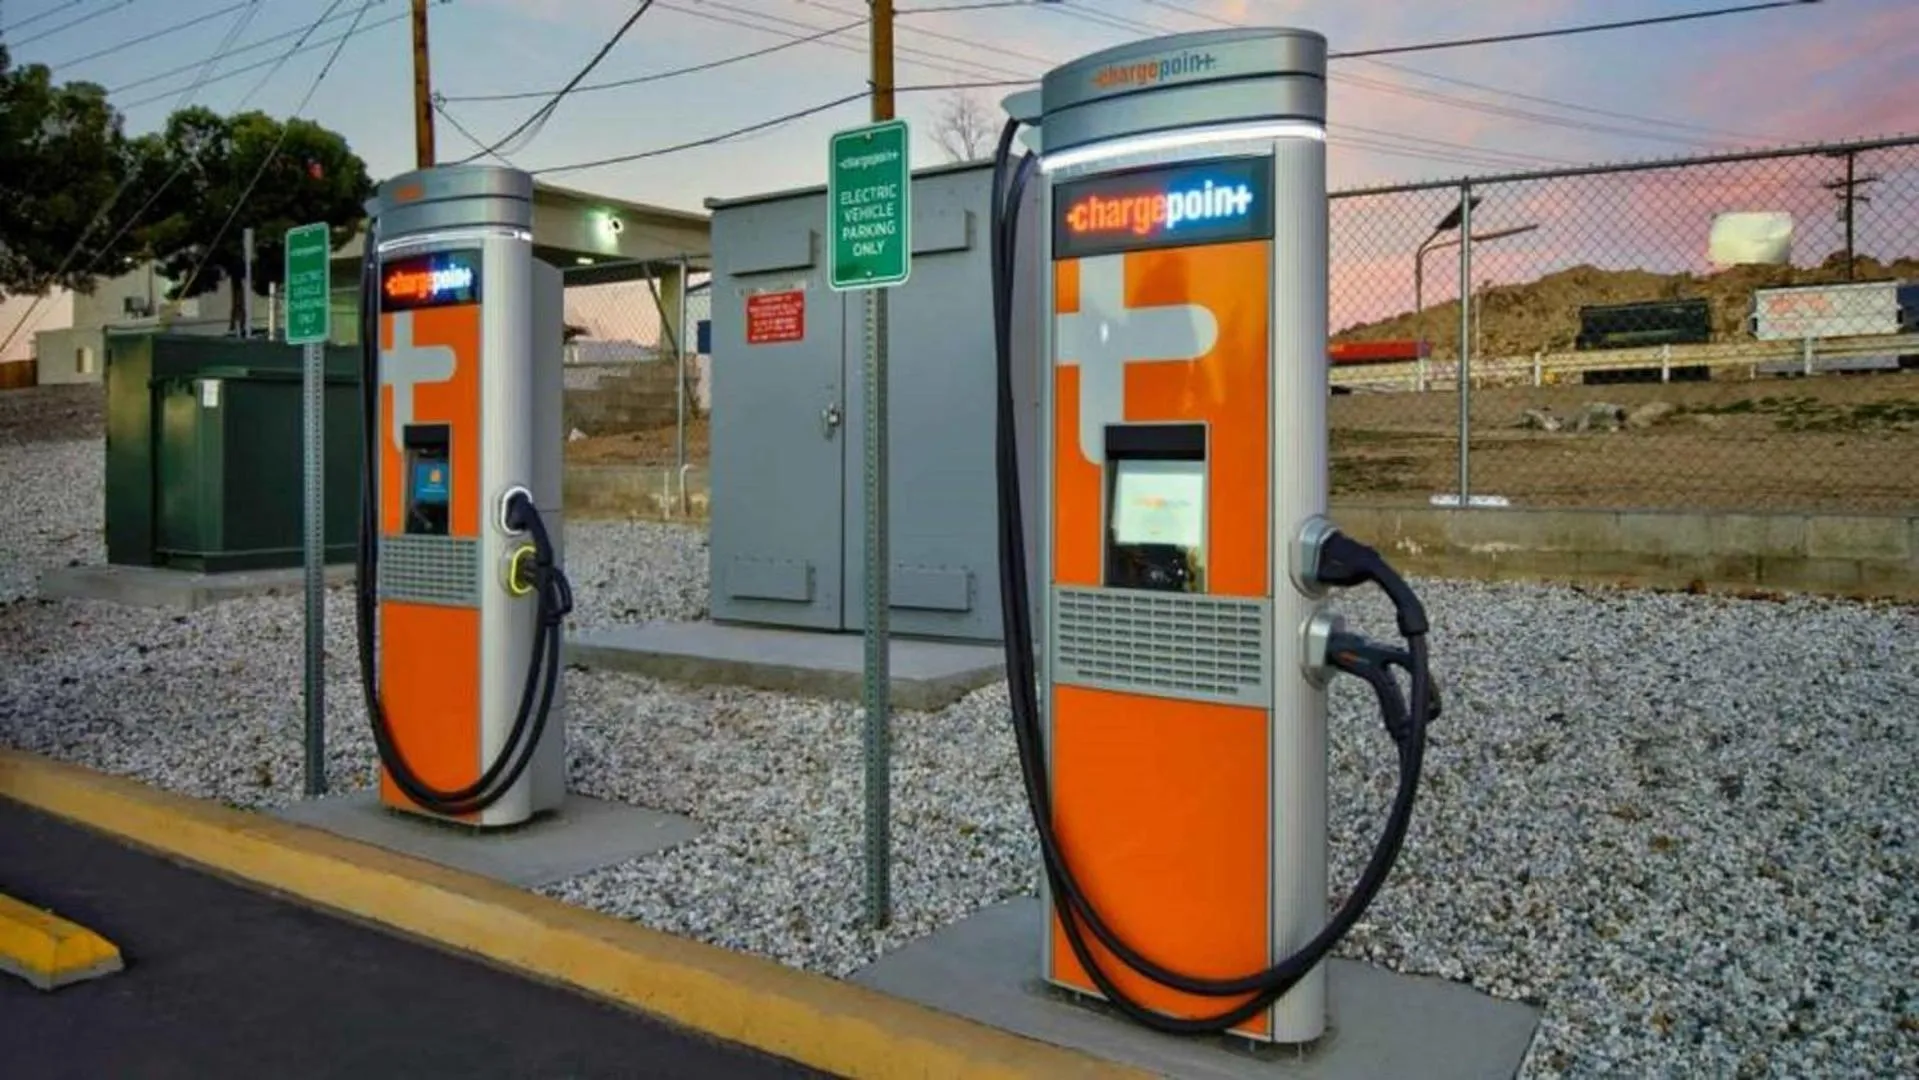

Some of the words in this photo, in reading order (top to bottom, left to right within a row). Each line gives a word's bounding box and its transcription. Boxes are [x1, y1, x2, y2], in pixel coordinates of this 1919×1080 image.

[840, 184, 897, 205] ELECTRIC
[844, 203, 894, 223] VEHICLE
[842, 220, 896, 241] PARKING
[852, 239, 885, 257] ONLY
